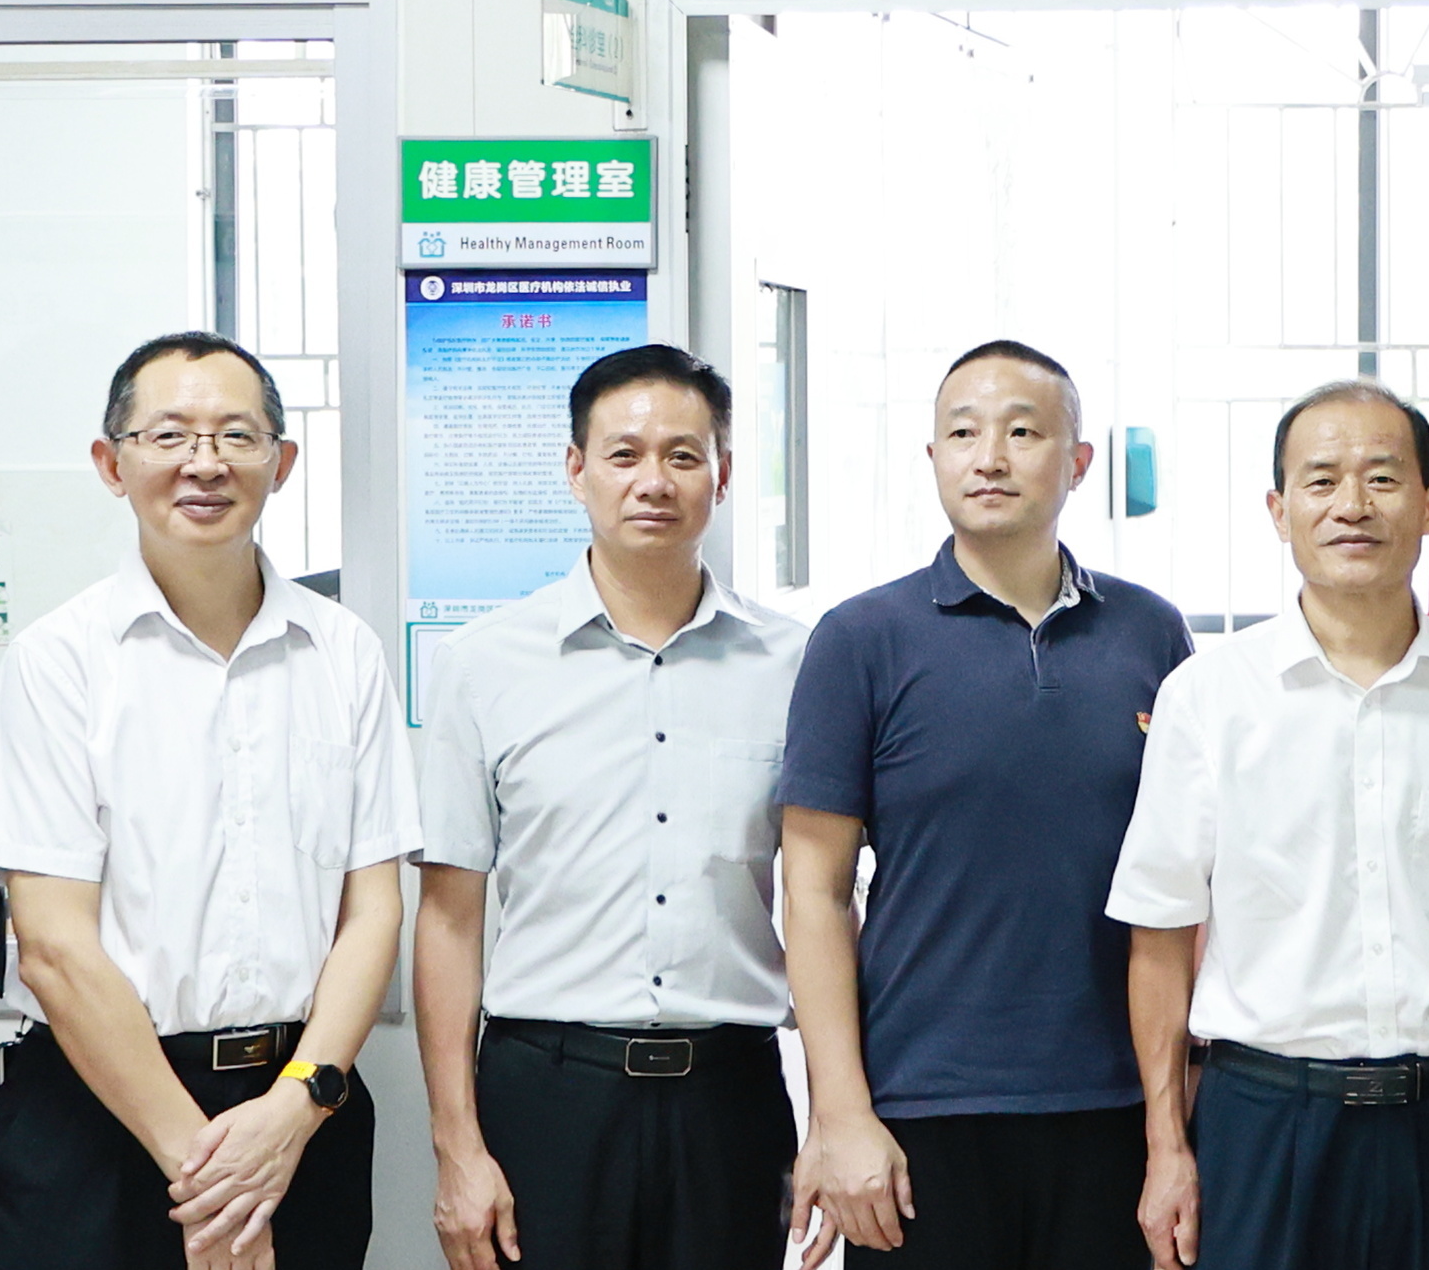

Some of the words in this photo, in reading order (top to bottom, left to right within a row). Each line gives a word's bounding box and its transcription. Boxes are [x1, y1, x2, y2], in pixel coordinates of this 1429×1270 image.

[419, 159, 635, 199] 健康管理室
[460, 236, 512, 252] Healthy
[515, 236, 603, 252] Management
[606, 236, 645, 250] Room
[501, 314, 552, 329] 承诺书
